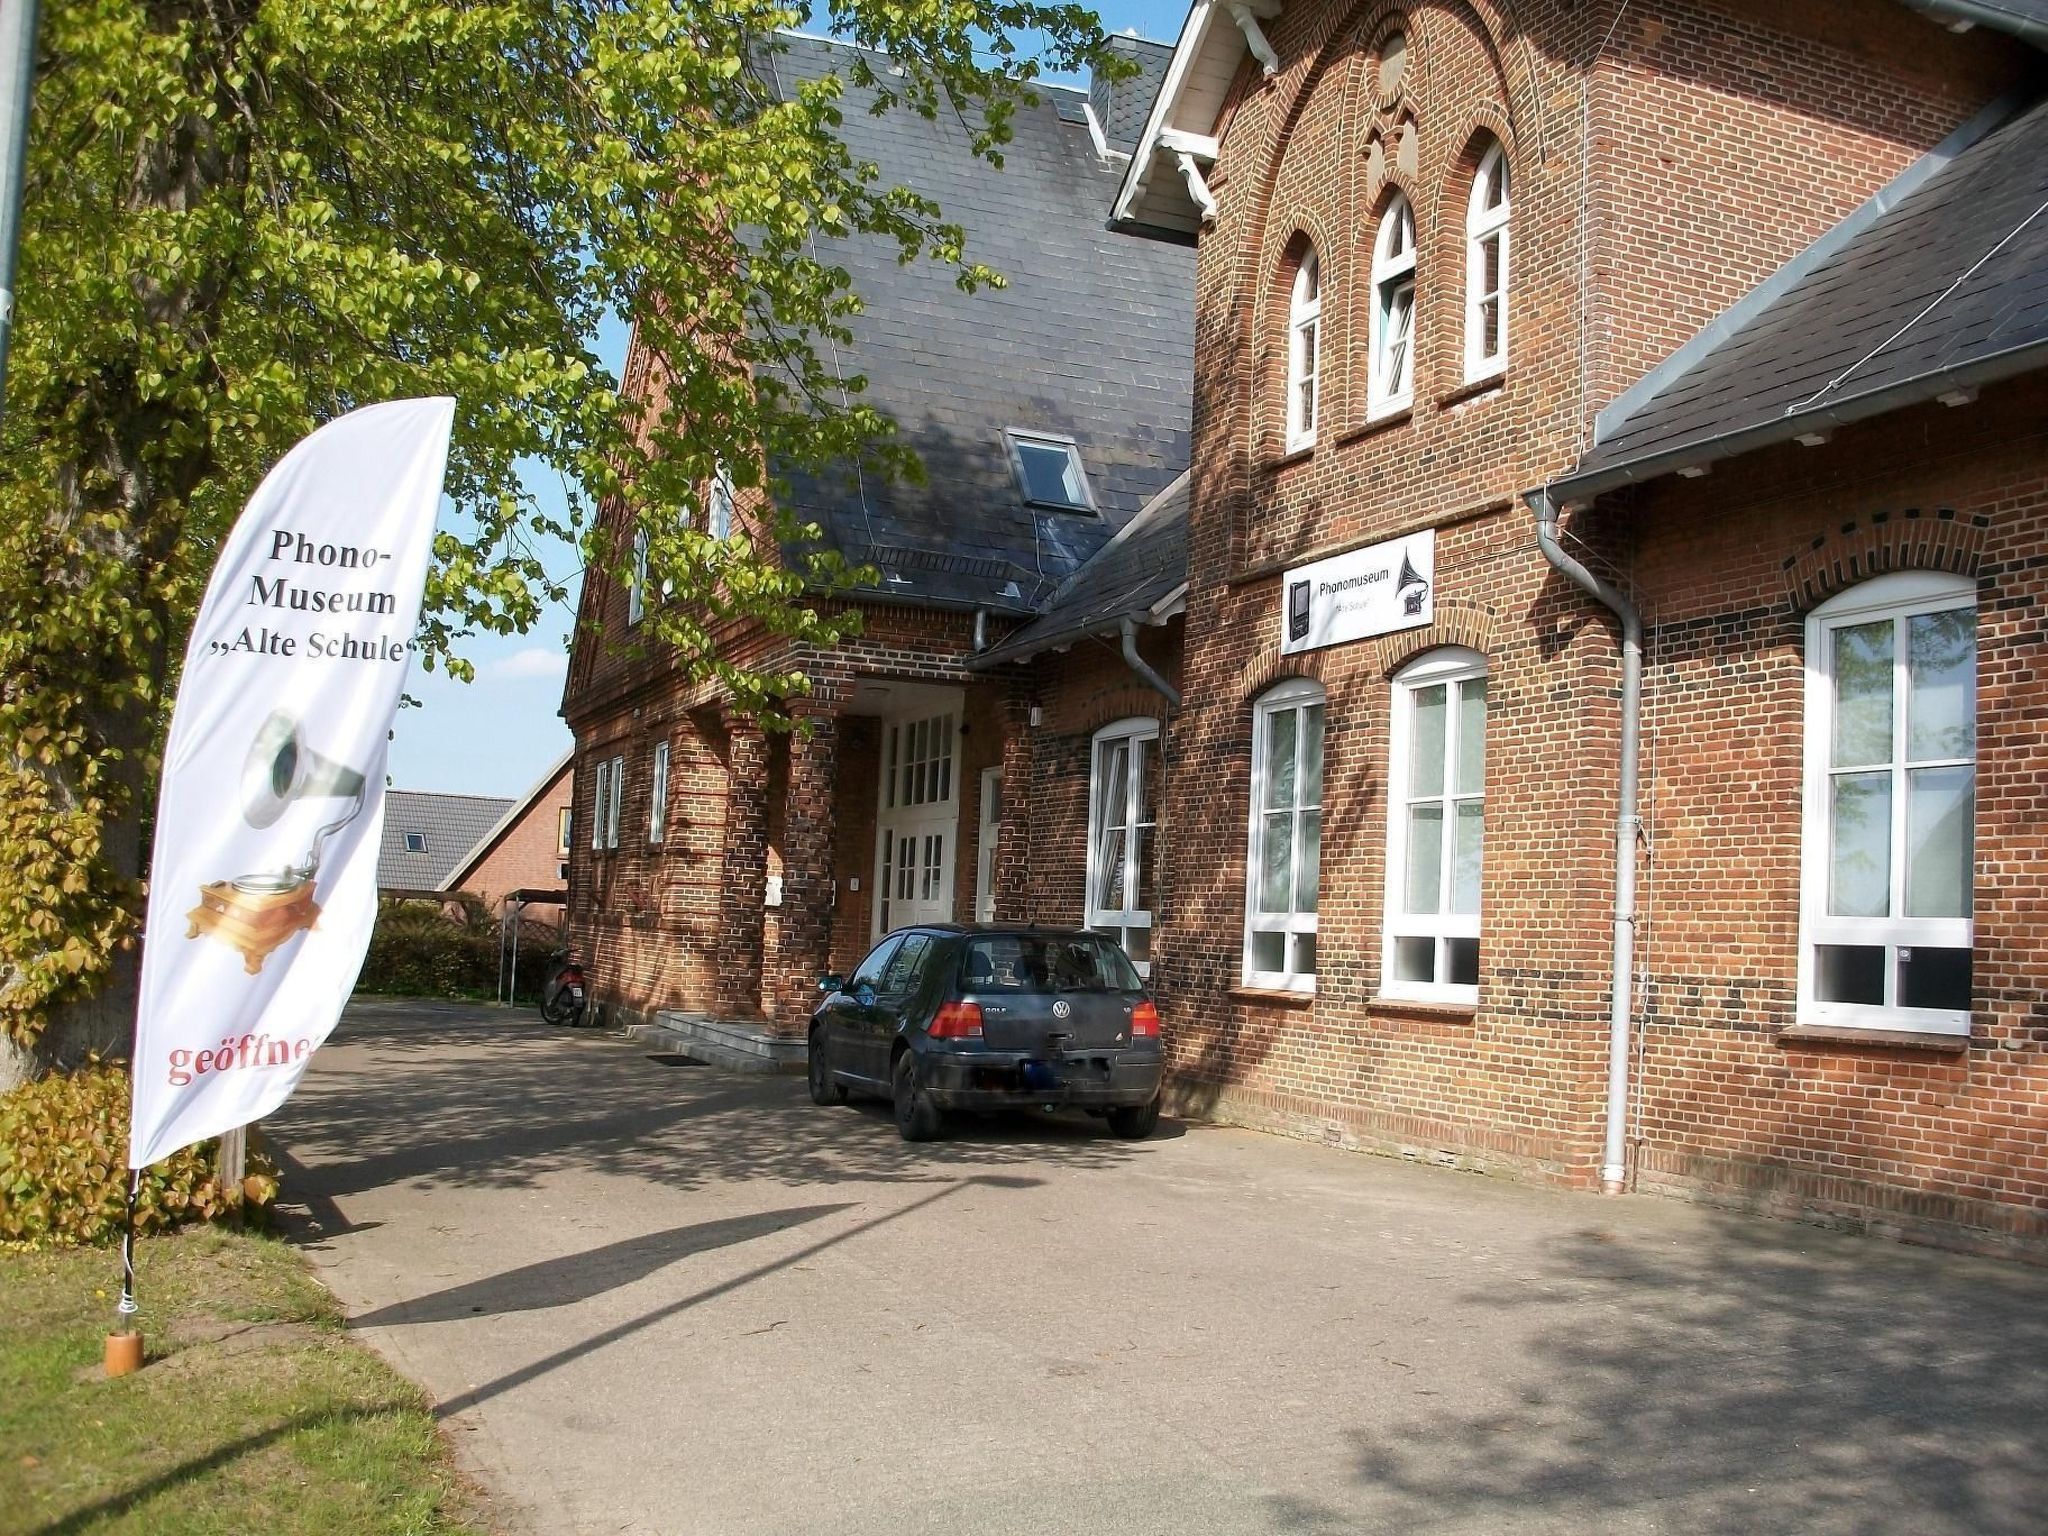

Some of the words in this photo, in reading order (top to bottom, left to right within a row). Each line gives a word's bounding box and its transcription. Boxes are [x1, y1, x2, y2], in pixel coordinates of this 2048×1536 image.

[268, 529, 392, 569] Phono-
[247, 575, 396, 614] Museum
[1319, 569, 1389, 597] Phonomuseum
[168, 1033, 315, 1087] geöffne
